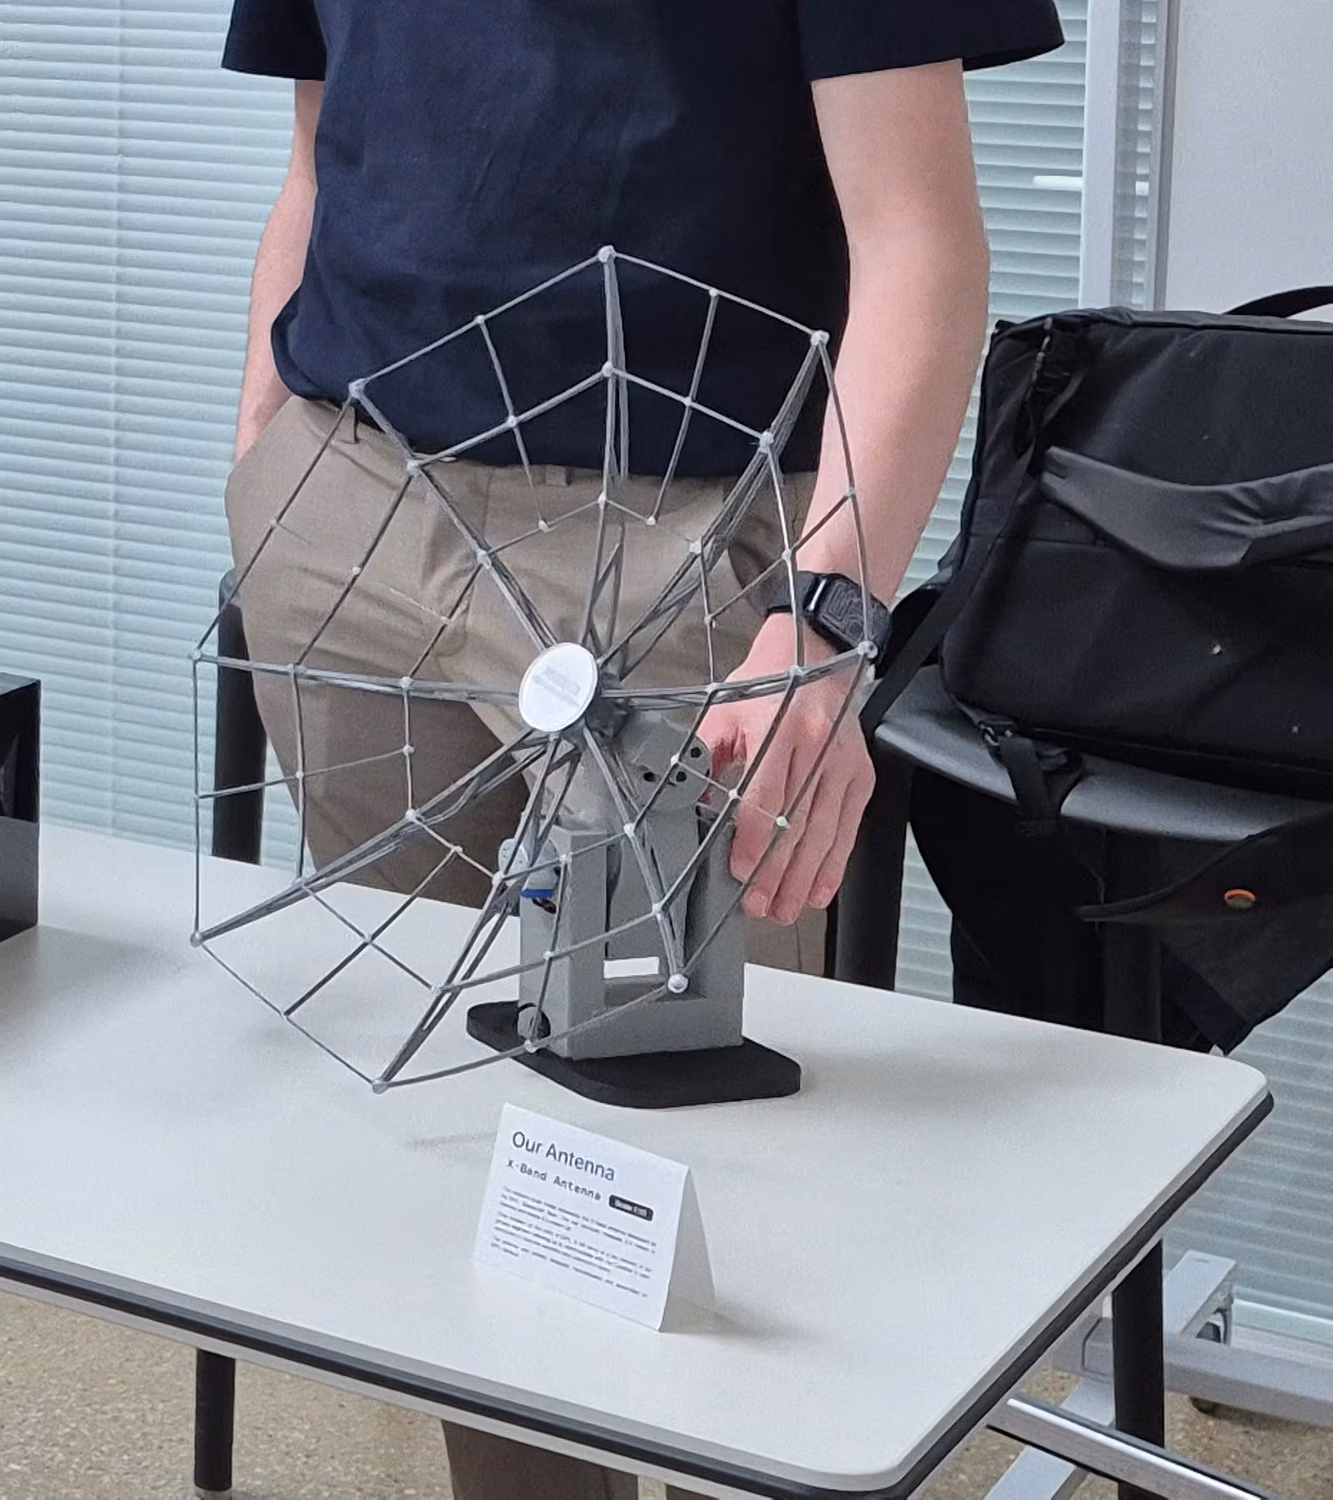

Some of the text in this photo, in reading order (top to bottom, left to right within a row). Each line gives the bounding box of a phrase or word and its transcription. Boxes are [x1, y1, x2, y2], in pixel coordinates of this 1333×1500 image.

[512, 1131, 615, 1182] Our Antenna
[553, 1176, 602, 1201] Antenna
